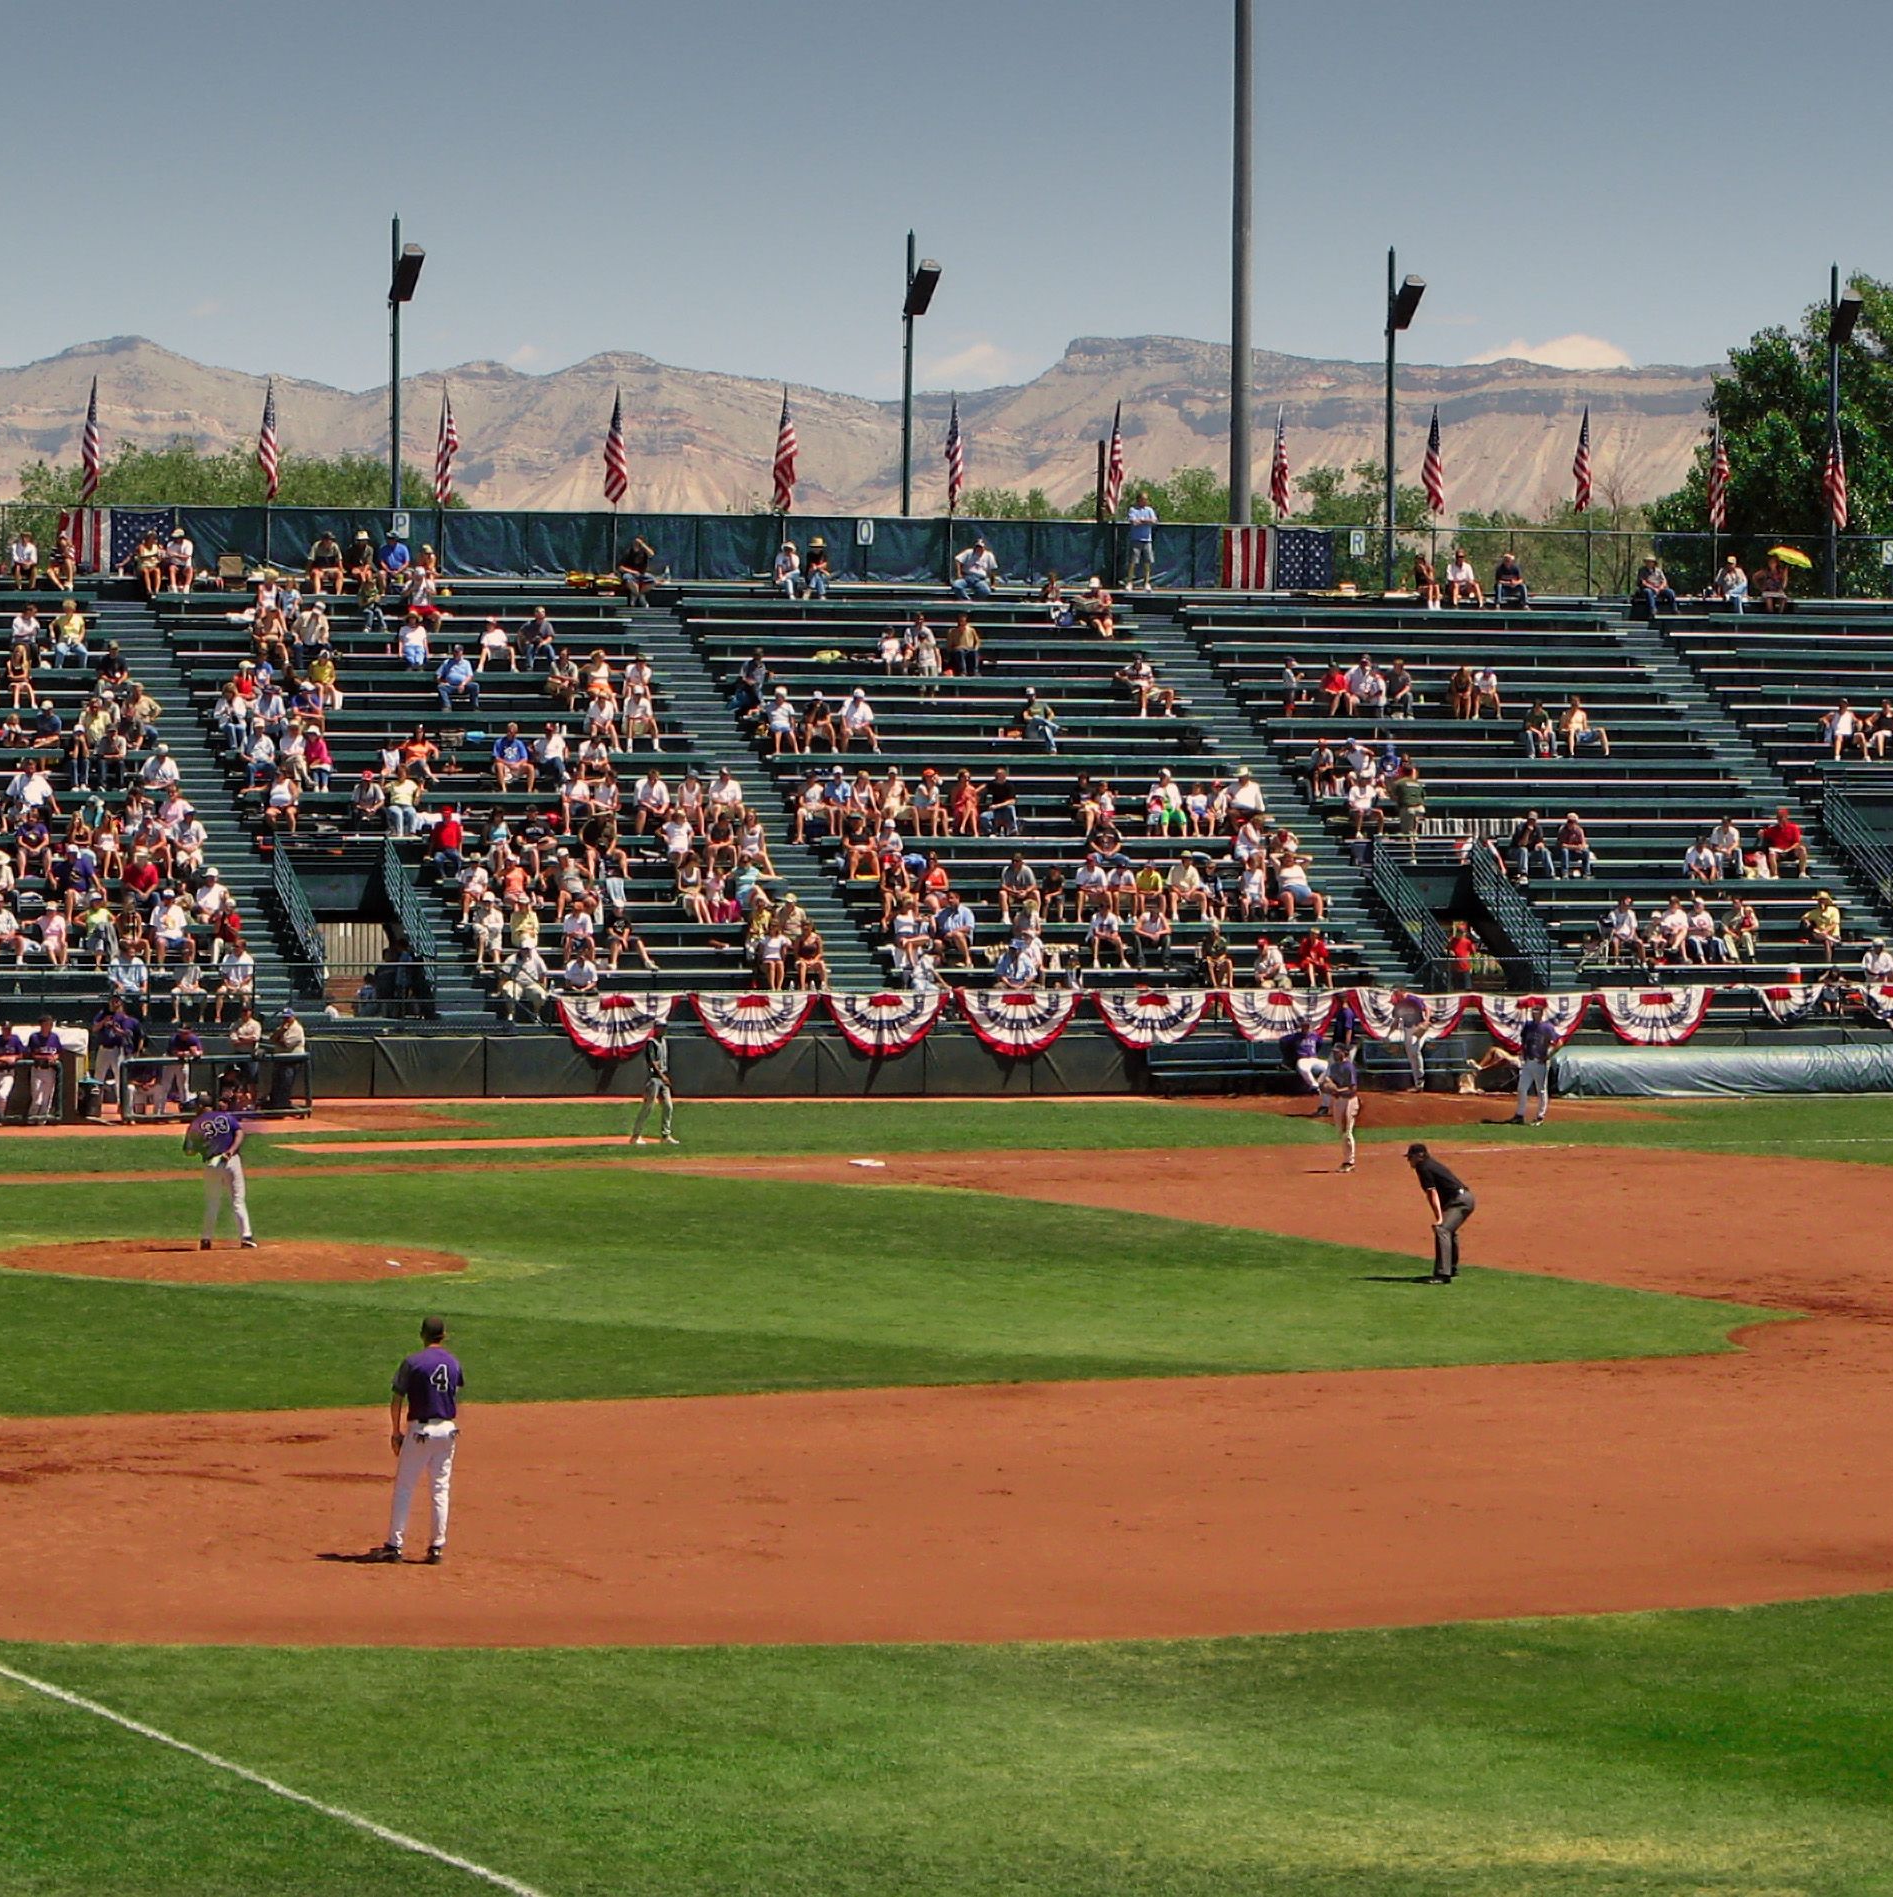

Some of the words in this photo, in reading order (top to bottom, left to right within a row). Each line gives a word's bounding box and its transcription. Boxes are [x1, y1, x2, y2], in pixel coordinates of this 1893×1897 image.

[395, 515, 407, 531] P
[1353, 532, 1363, 553] R
[201, 1115, 230, 1138] 33
[430, 1364, 448, 1392] 4
